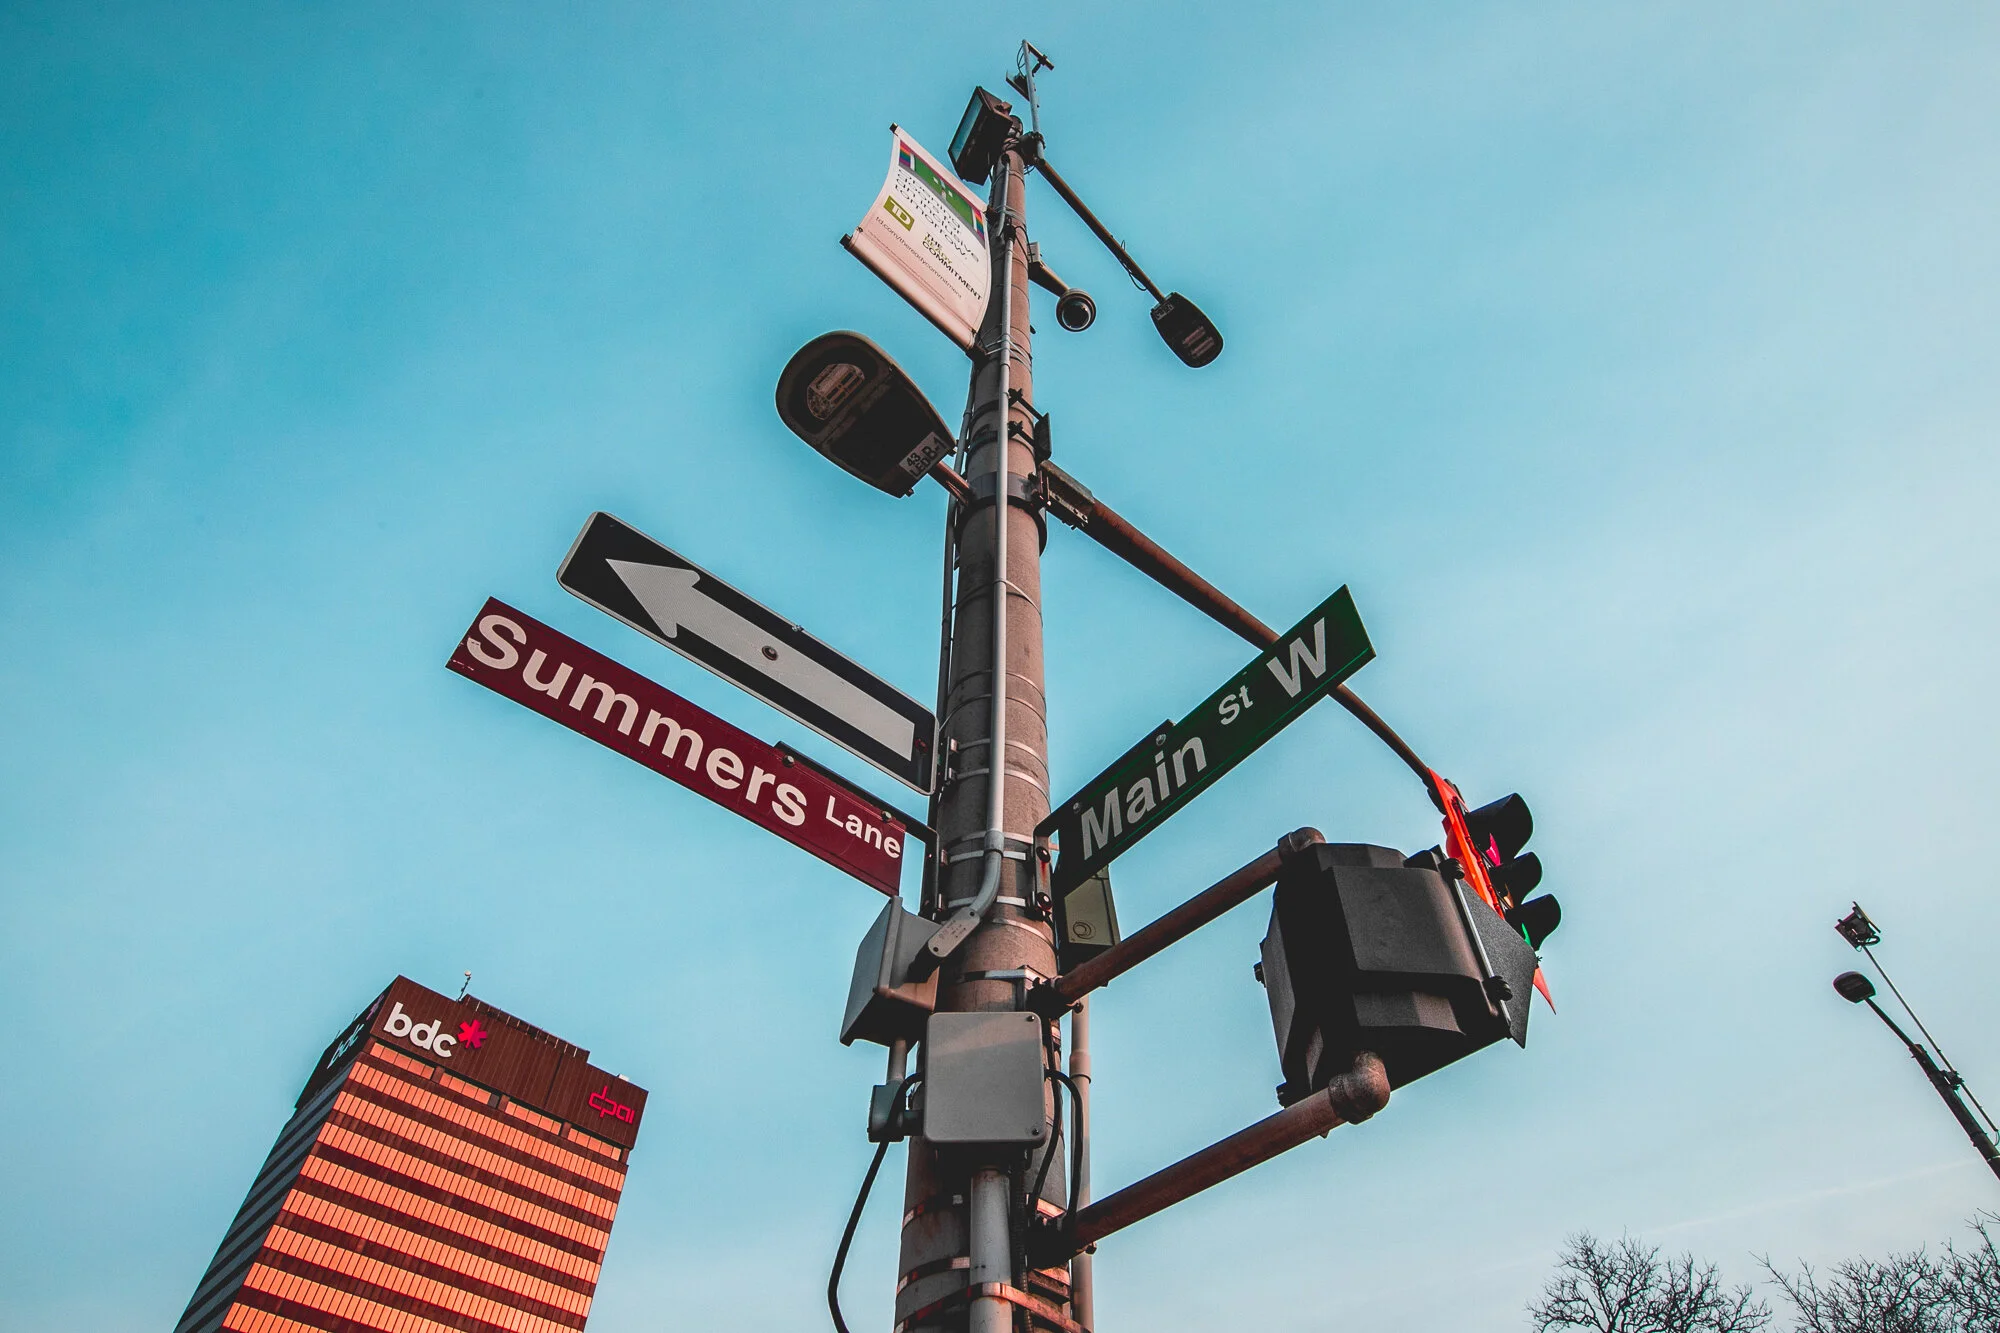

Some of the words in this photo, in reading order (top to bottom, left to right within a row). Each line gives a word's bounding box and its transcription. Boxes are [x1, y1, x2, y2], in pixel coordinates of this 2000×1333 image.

[894, 184, 969, 260] tomorrow.
[896, 178, 916, 198] an
[920, 199, 980, 262] inclusive
[926, 231, 943, 251] THE
[922, 241, 982, 300] COMMITMENT
[924, 236, 953, 264] READY
[906, 452, 921, 466] 43
[910, 457, 930, 477] LED
[922, 436, 949, 460] B-1
[466, 614, 808, 827] Summers
[825, 795, 901, 859] Lane
[1081, 736, 1207, 860] Main
[1218, 685, 1254, 725] St
[1266, 617, 1327, 698] W
[383, 1001, 457, 1058] bdc
